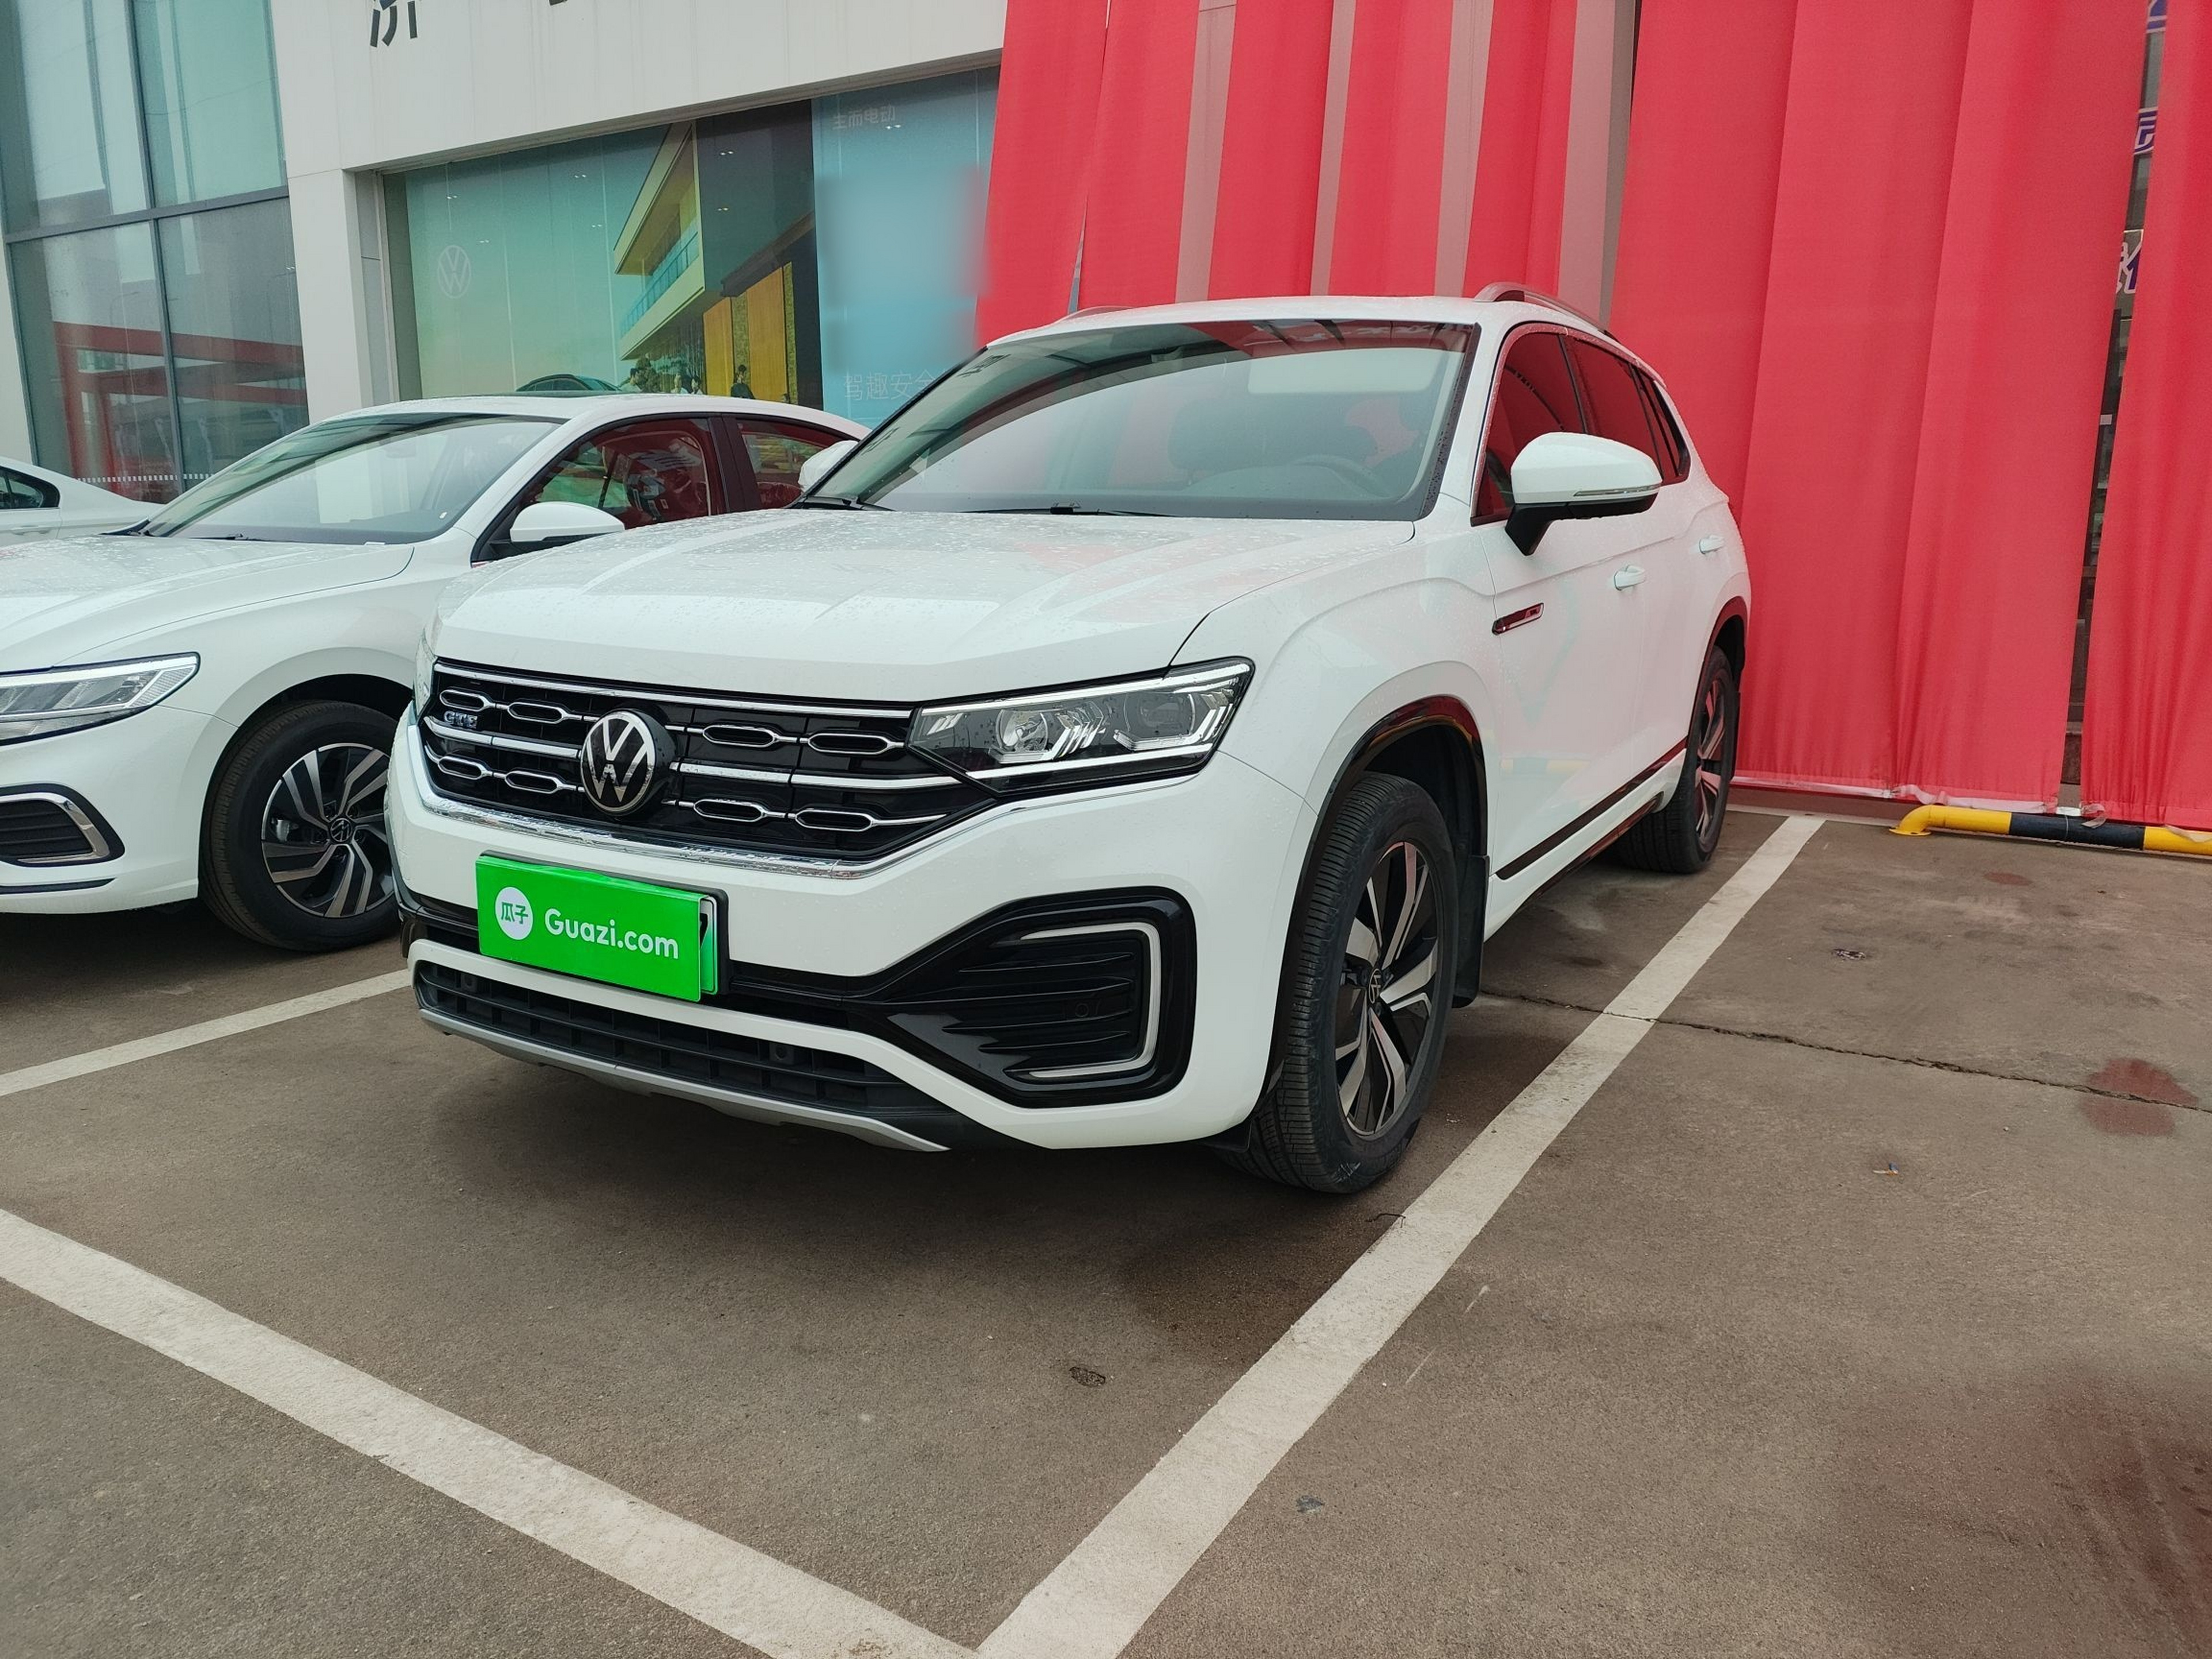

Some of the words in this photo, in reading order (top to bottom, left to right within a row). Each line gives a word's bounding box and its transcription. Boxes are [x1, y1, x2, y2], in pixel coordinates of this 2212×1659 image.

[443, 710, 478, 729] GTE
[501, 902, 528, 925] 瓜子
[544, 908, 679, 960] Guazi.com
